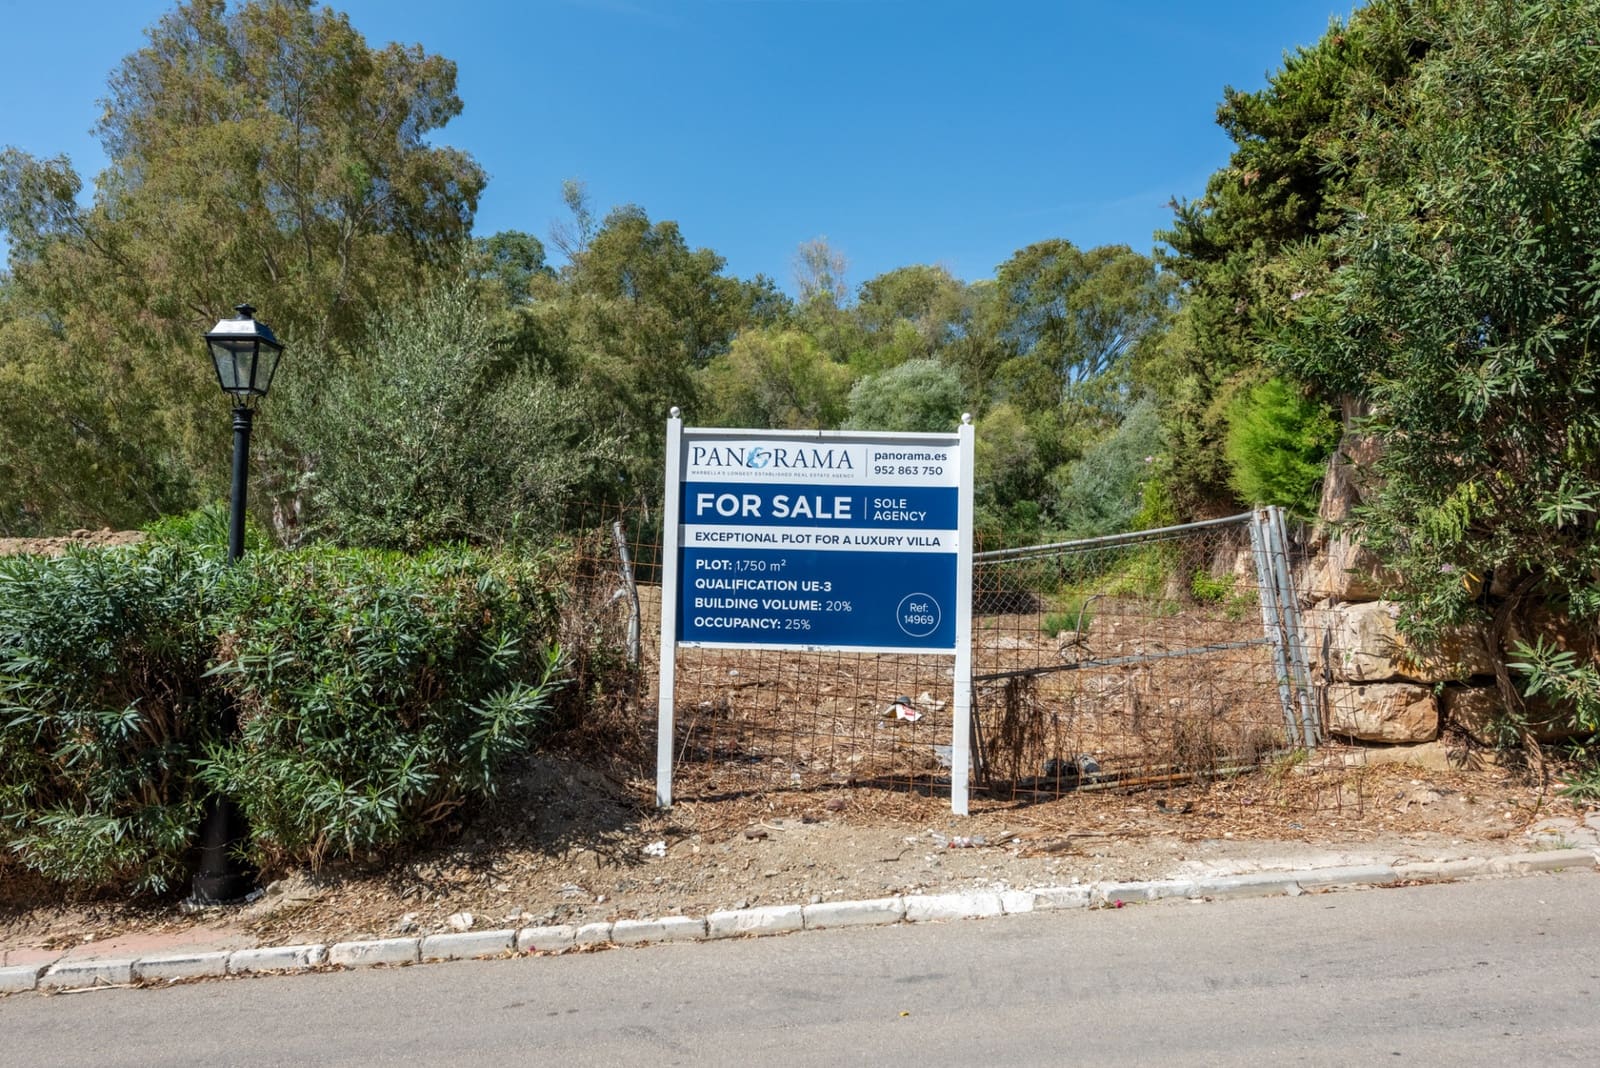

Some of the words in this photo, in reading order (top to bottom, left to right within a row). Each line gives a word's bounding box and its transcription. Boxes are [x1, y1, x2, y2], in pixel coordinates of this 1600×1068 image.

[692, 446, 854, 469] PANORAMA
[874, 451, 948, 462] panorama.es
[874, 465, 895, 475] 952
[898, 466, 919, 475] 863
[922, 466, 943, 476] 750
[697, 493, 762, 517] FOR
[772, 495, 852, 519] SALE
[873, 498, 907, 509] SOLE
[873, 510, 927, 521] AGENCY
[695, 531, 778, 543] EXCEPTIONAL
[781, 534, 812, 544] PLOT
[815, 535, 840, 545] FOR
[842, 535, 852, 545] A
[855, 535, 903, 546] LUXURY
[906, 537, 941, 547] VILLA
[696, 559, 733, 570] PLOT:
[735, 560, 766, 572] 1,750
[695, 578, 798, 591] QUALIFICATION
[801, 581, 832, 592] UE-3
[695, 597, 758, 609] BUILDING
[762, 599, 822, 611] VOLUME:
[826, 600, 852, 612] 20%
[910, 603, 929, 613] Ref:
[694, 616, 781, 629] OCCUPANCY:
[785, 618, 811, 630] 25%
[904, 614, 935, 625] 14969
